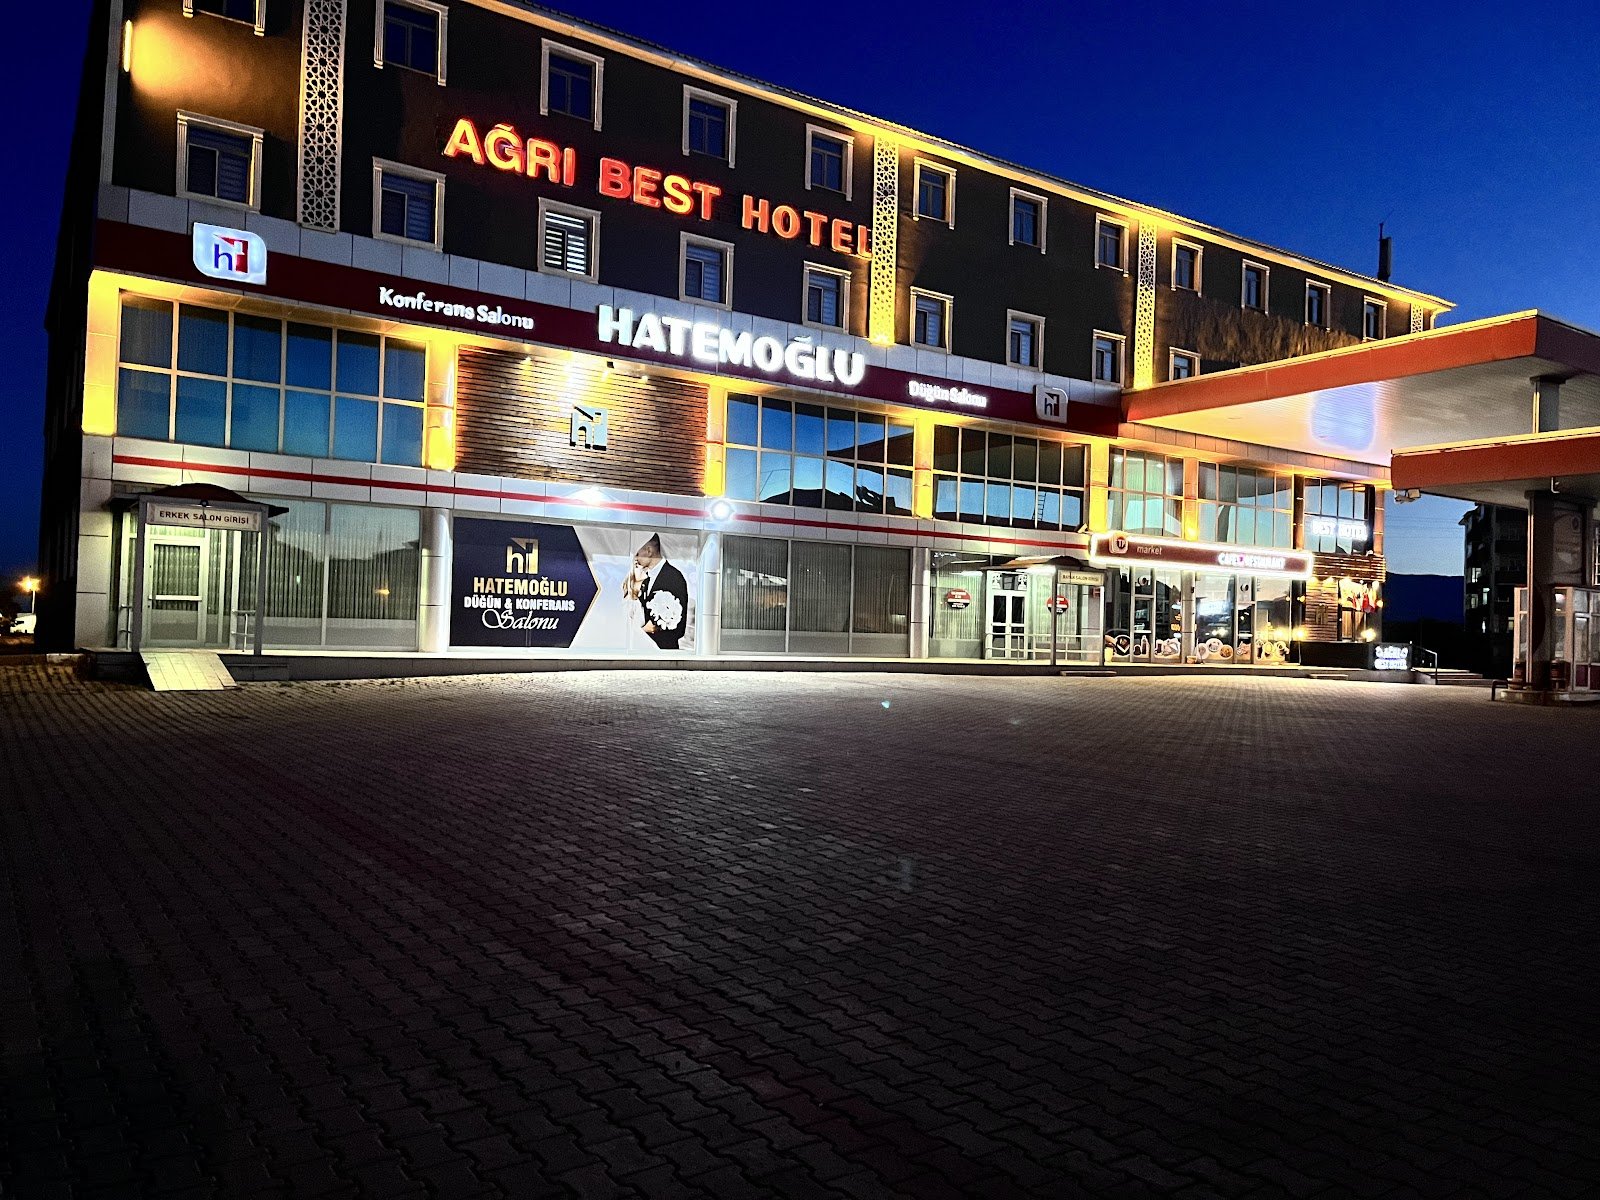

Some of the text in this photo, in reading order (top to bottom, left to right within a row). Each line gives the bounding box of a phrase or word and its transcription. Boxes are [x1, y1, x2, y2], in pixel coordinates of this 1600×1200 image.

[443, 118, 873, 258] AĞRI BEST HOTEL
[379, 287, 534, 330] Konferans Salonu
[598, 304, 866, 386] HATEMOĞLU
[908, 380, 949, 402] Düğün
[159, 510, 190, 520] ERKEK
[193, 513, 222, 522] SALON
[1136, 544, 1163, 555] market
[473, 576, 568, 597] HATEMOĞLU
[463, 594, 576, 612] DÜĞÜN & KONFERANS
[481, 609, 560, 630] Salonu
